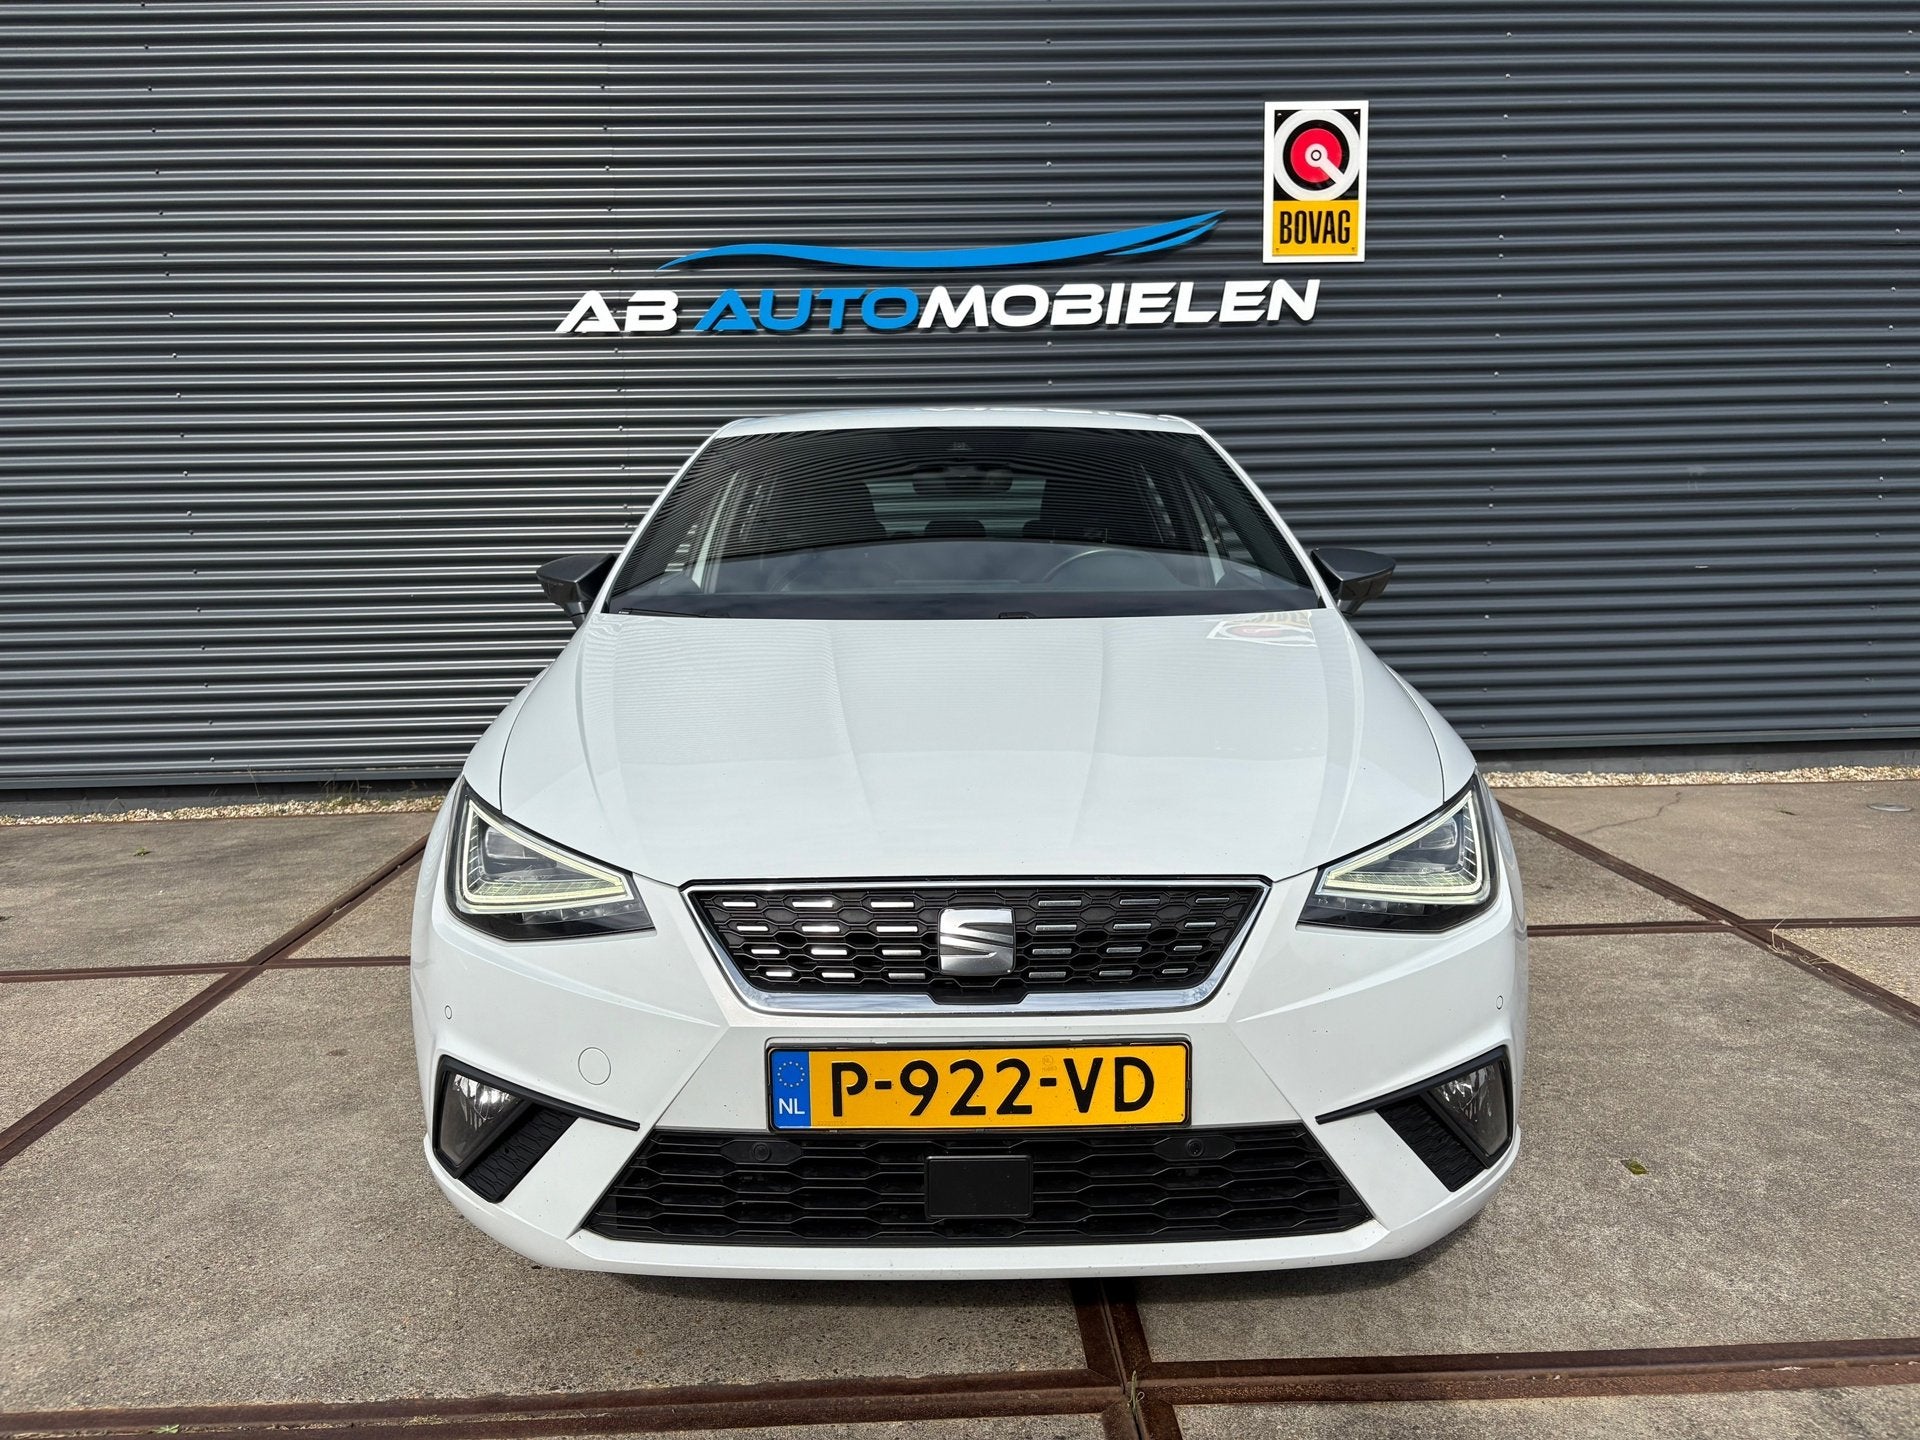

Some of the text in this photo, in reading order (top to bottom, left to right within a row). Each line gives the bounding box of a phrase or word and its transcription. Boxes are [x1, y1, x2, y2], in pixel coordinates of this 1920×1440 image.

[1280, 210, 1350, 244] BOVAG
[554, 279, 1320, 333] AB AUTOMOBIELEN
[779, 1098, 805, 1115] NL
[832, 1057, 1154, 1117] P-922-VD
